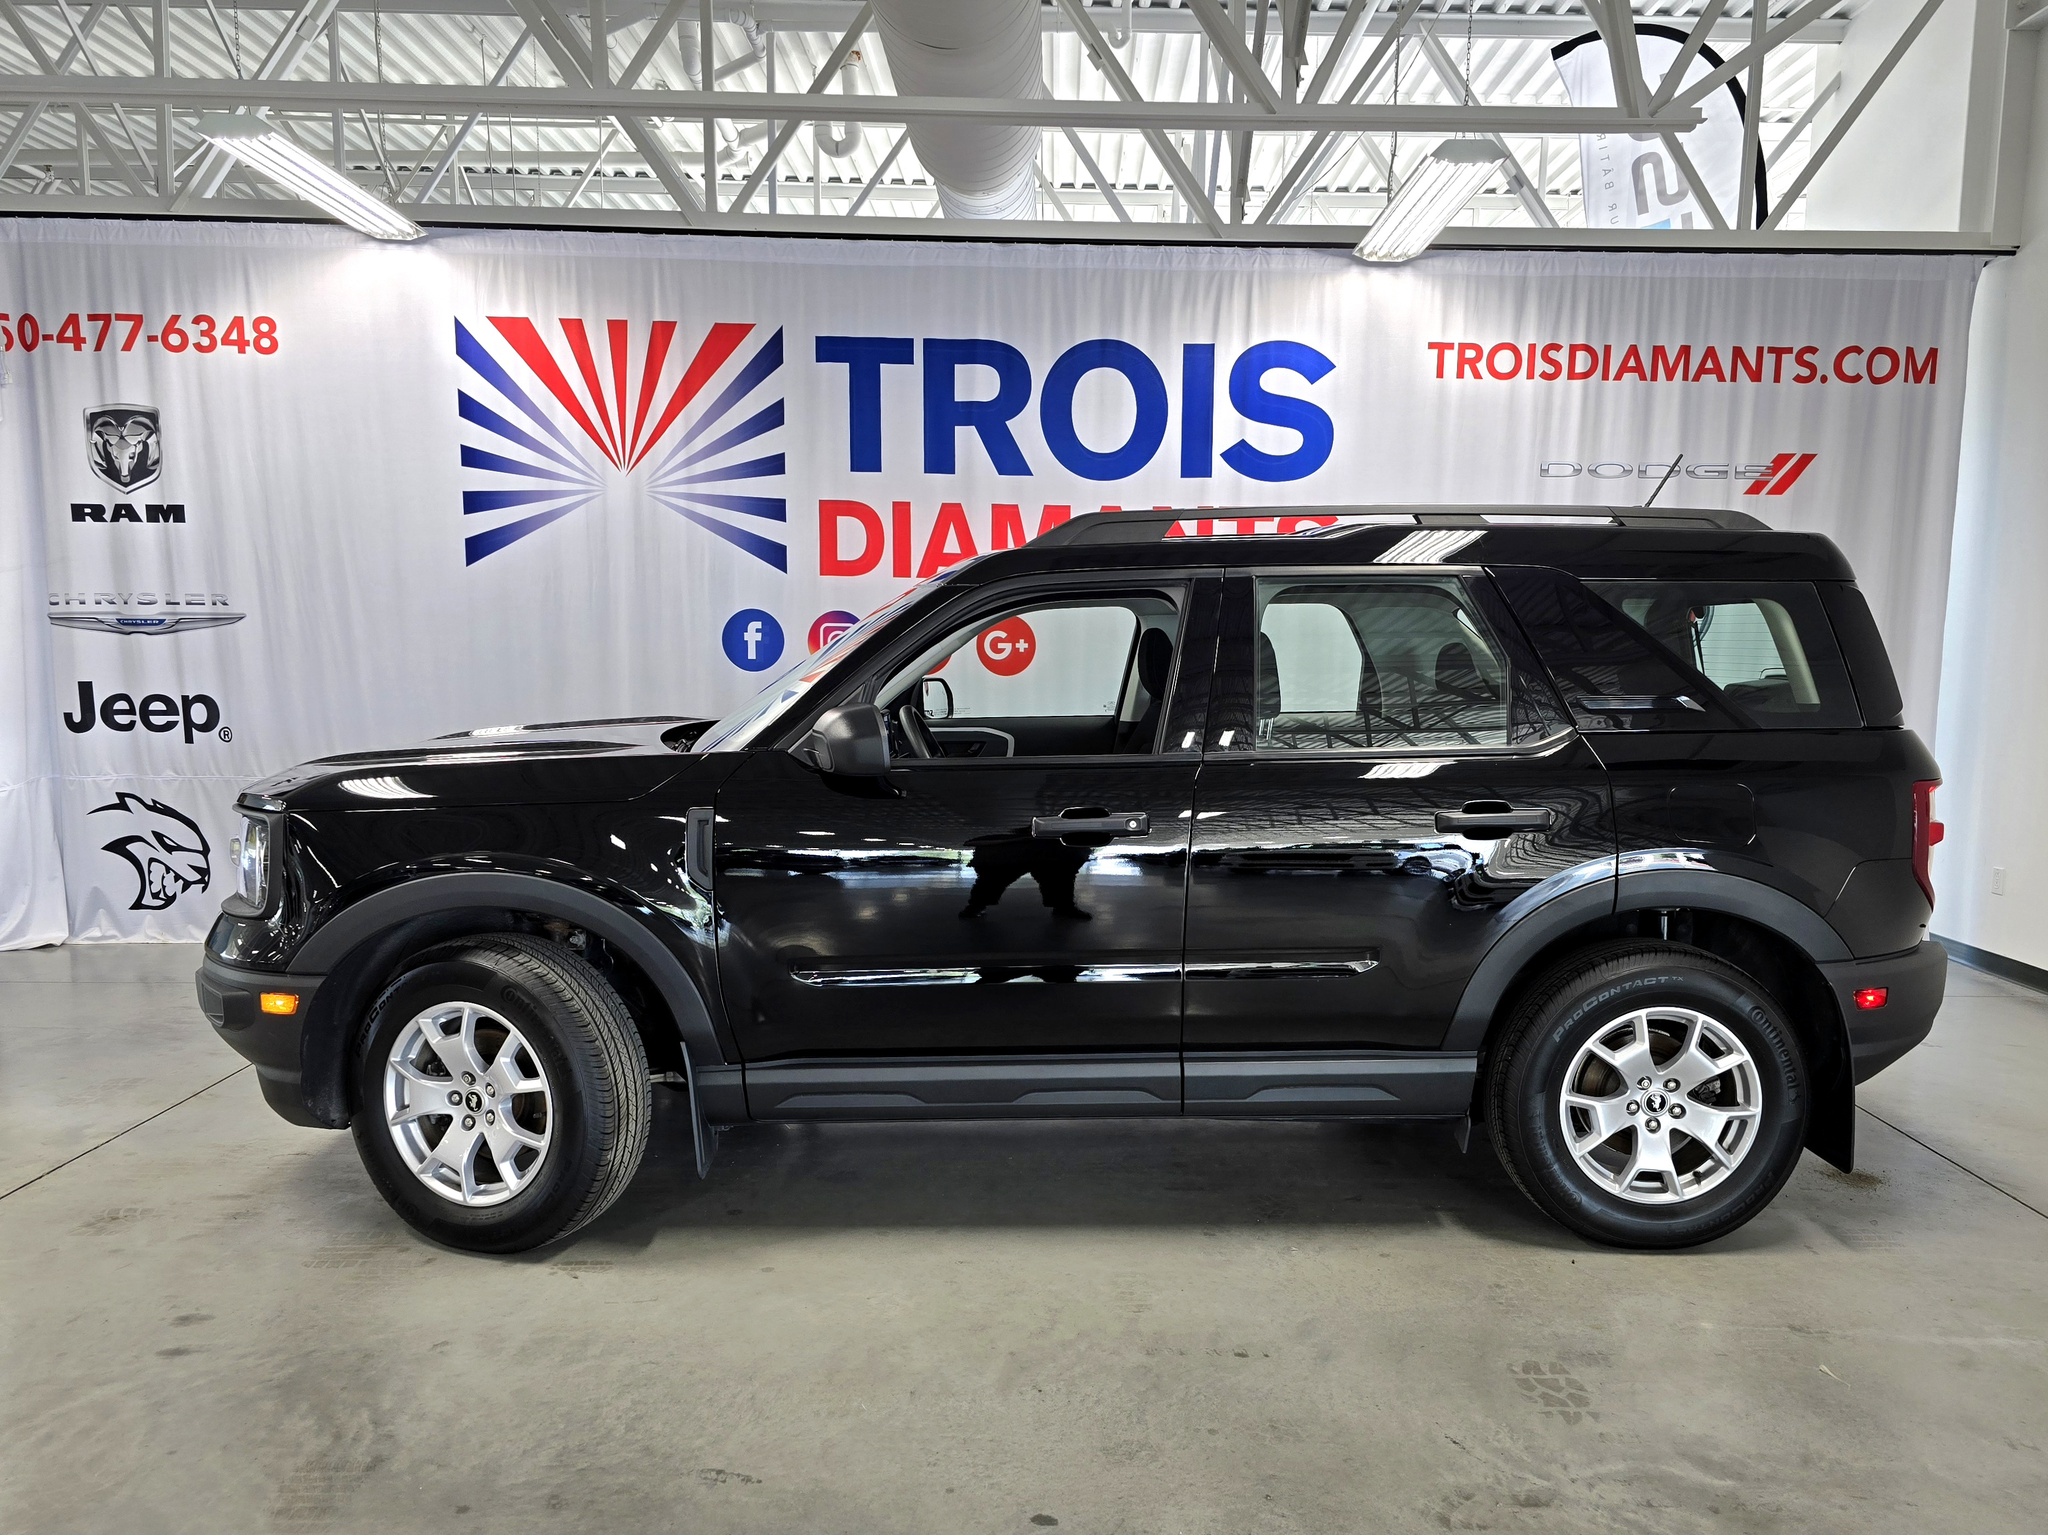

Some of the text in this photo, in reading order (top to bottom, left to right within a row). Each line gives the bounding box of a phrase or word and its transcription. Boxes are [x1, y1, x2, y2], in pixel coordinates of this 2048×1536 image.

[1428, 342, 1938, 384] TROISDIAMANTS.COM
[816, 336, 1336, 482] TROIS
[1539, 460, 1774, 480] DODGE
[71, 503, 186, 523] RAM
[48, 592, 230, 607] CHRYSLER
[64, 681, 220, 744] Jeep
